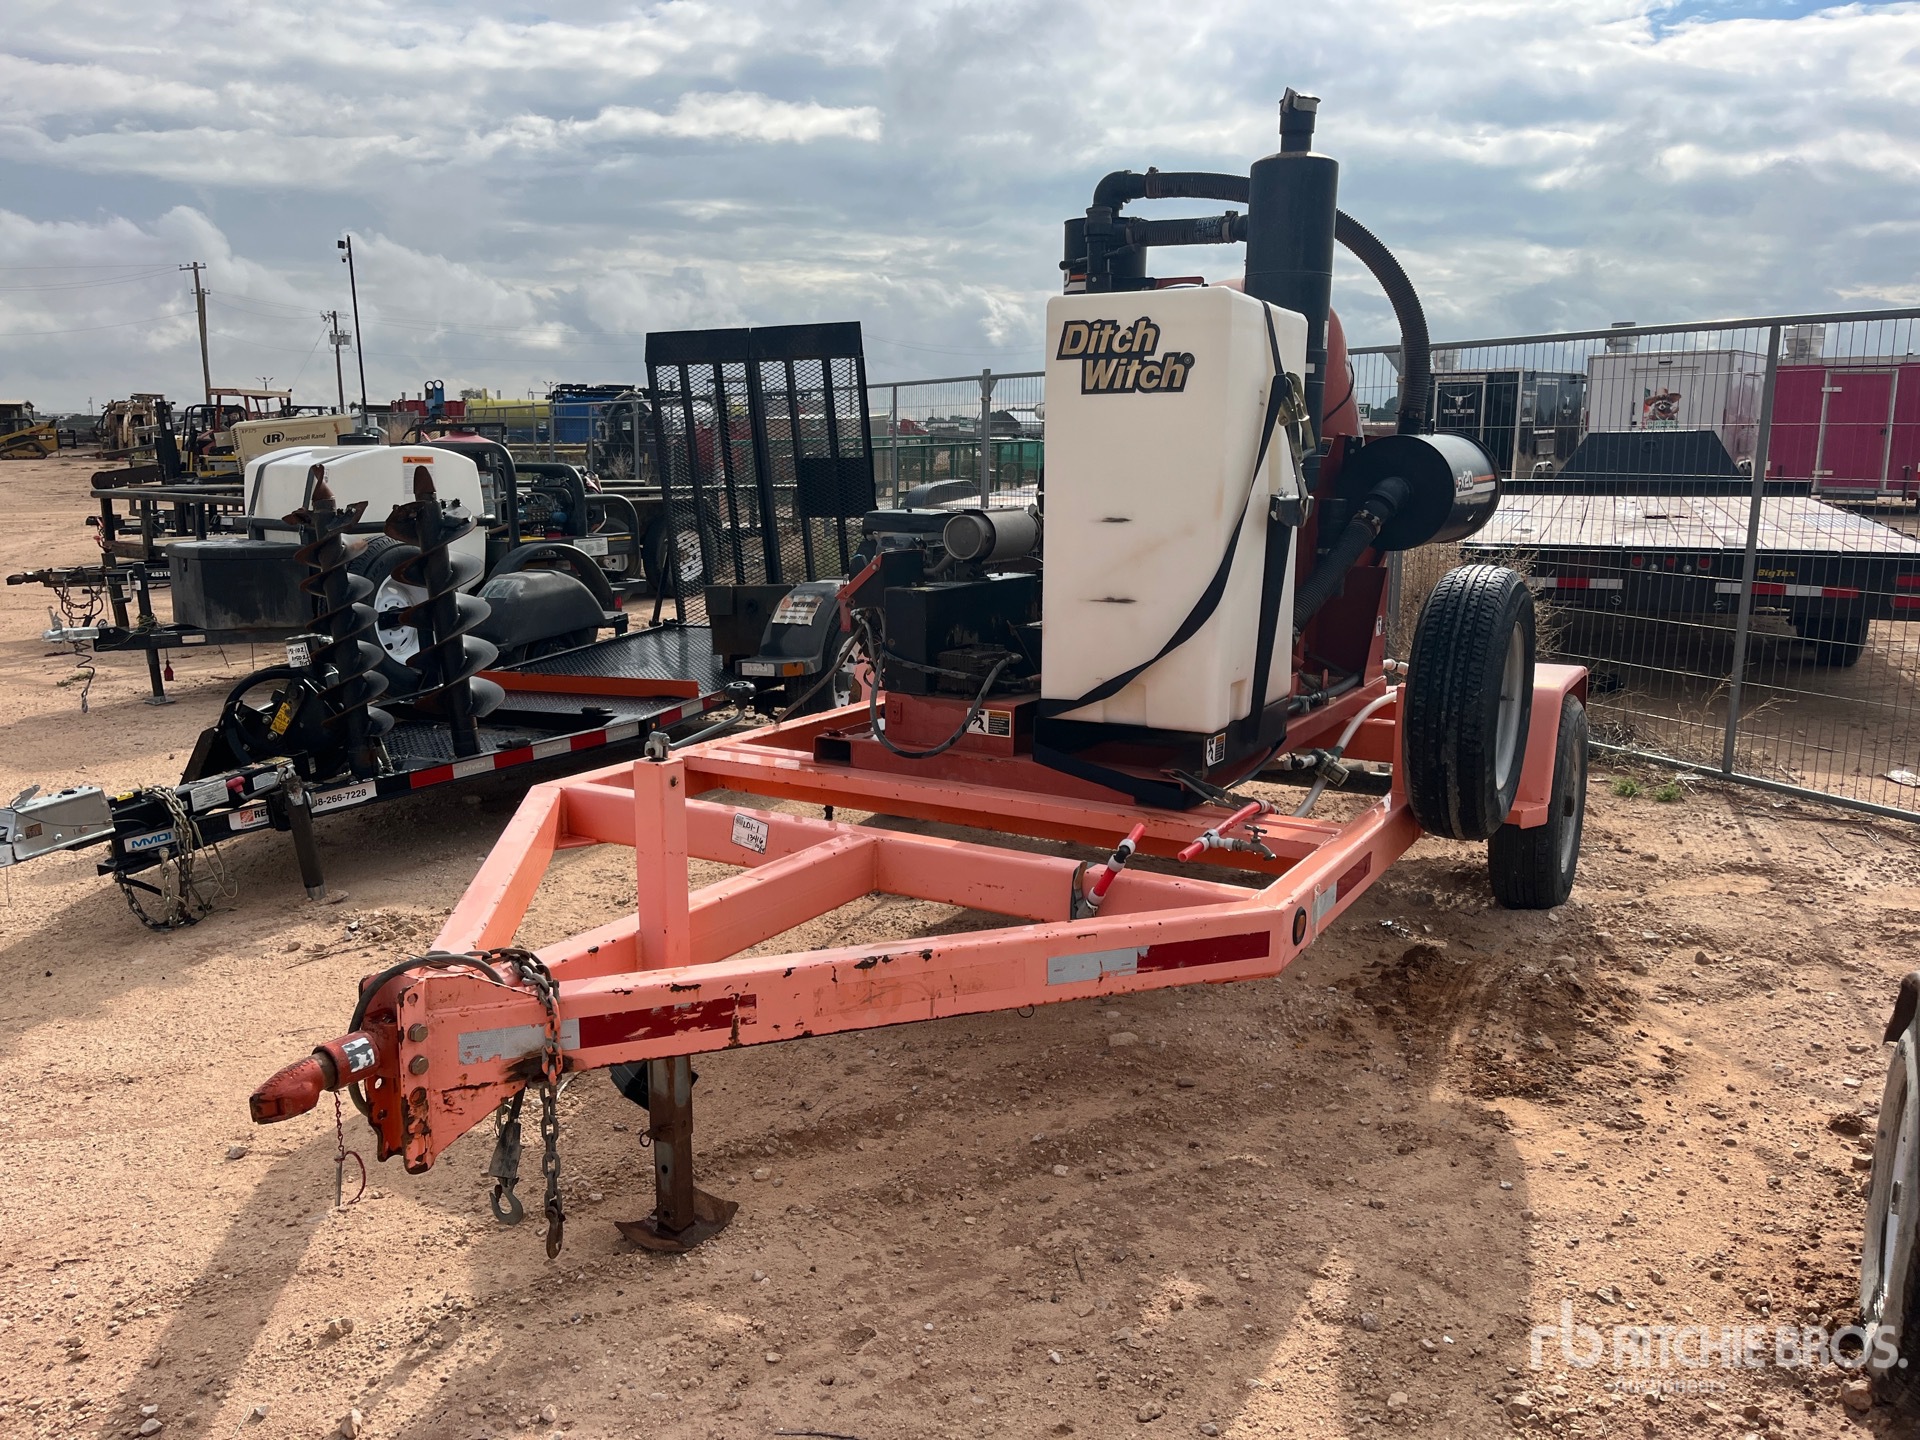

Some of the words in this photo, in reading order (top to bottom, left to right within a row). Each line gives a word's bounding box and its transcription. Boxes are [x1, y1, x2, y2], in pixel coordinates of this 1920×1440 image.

[1060, 319, 1158, 356] Ditch
[1084, 356, 1186, 390] Witch
[286, 434, 311, 443] Ingersoll
[131, 831, 172, 849] MMDI
